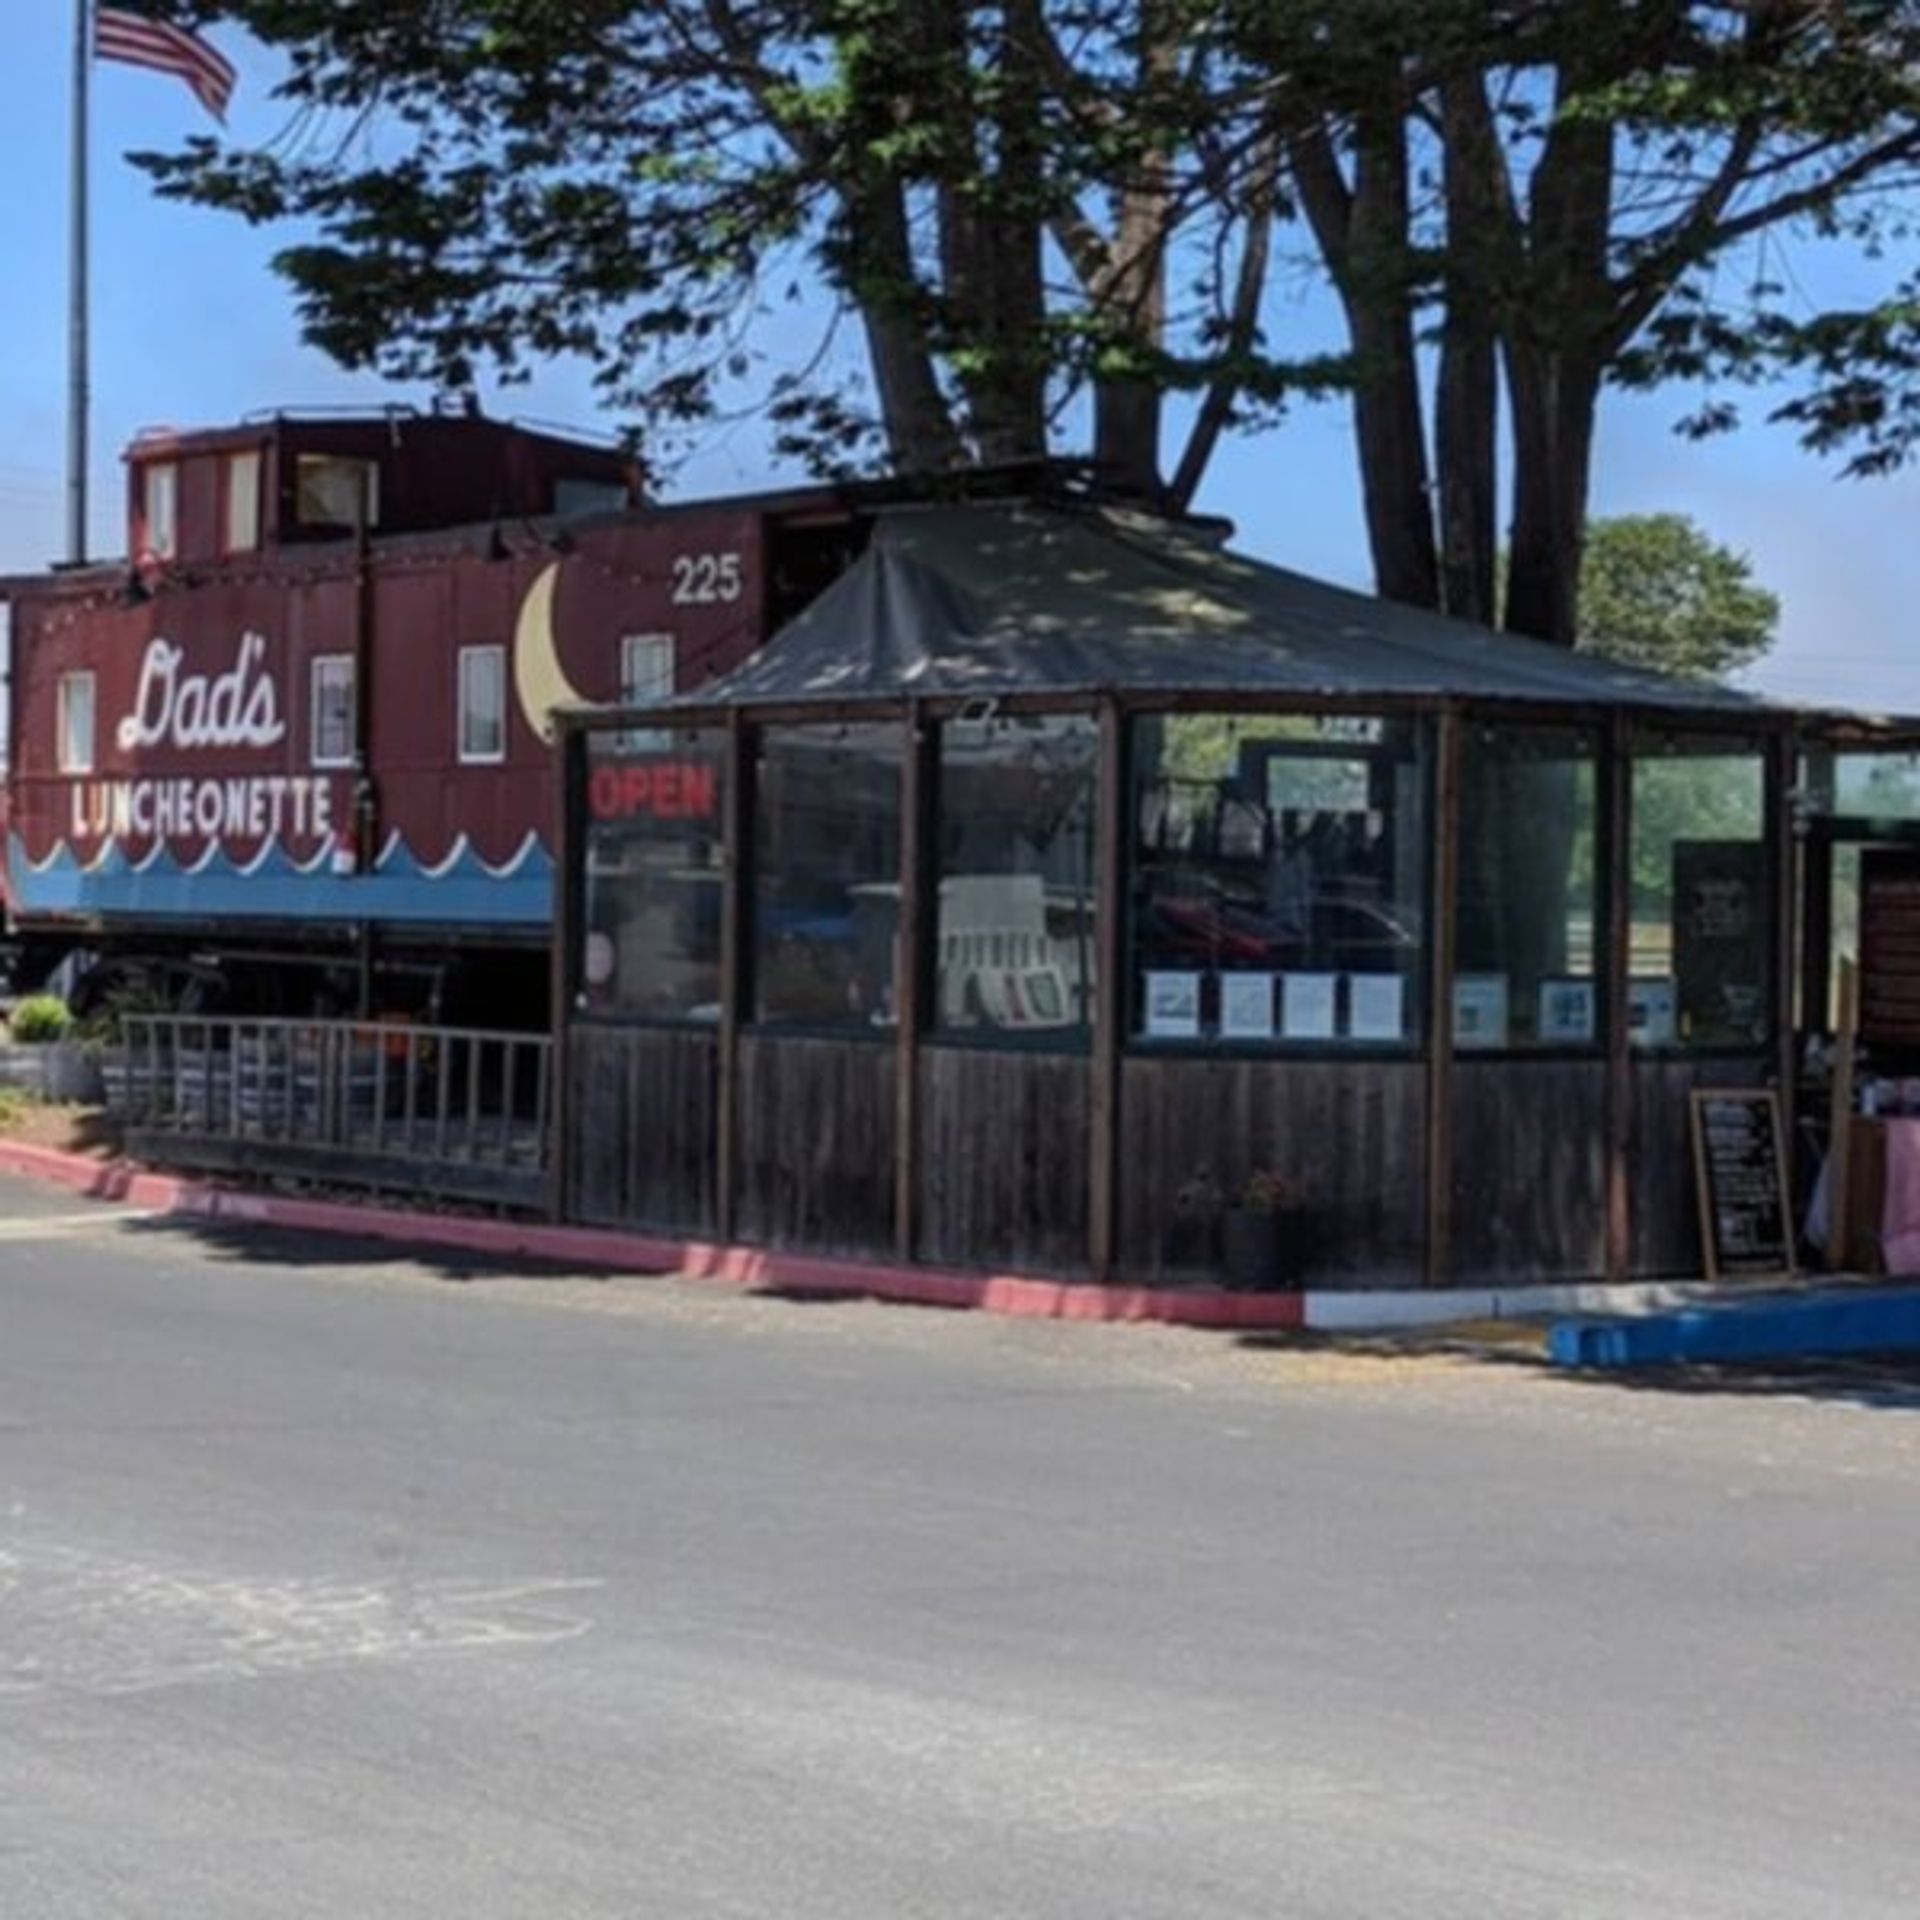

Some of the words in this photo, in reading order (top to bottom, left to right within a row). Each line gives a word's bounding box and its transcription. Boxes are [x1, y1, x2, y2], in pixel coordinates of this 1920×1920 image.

[673, 554, 742, 604] 225
[117, 632, 285, 749] Dad's
[71, 777, 333, 837] LUNCHEONETTE
[589, 764, 716, 819] OPEN
